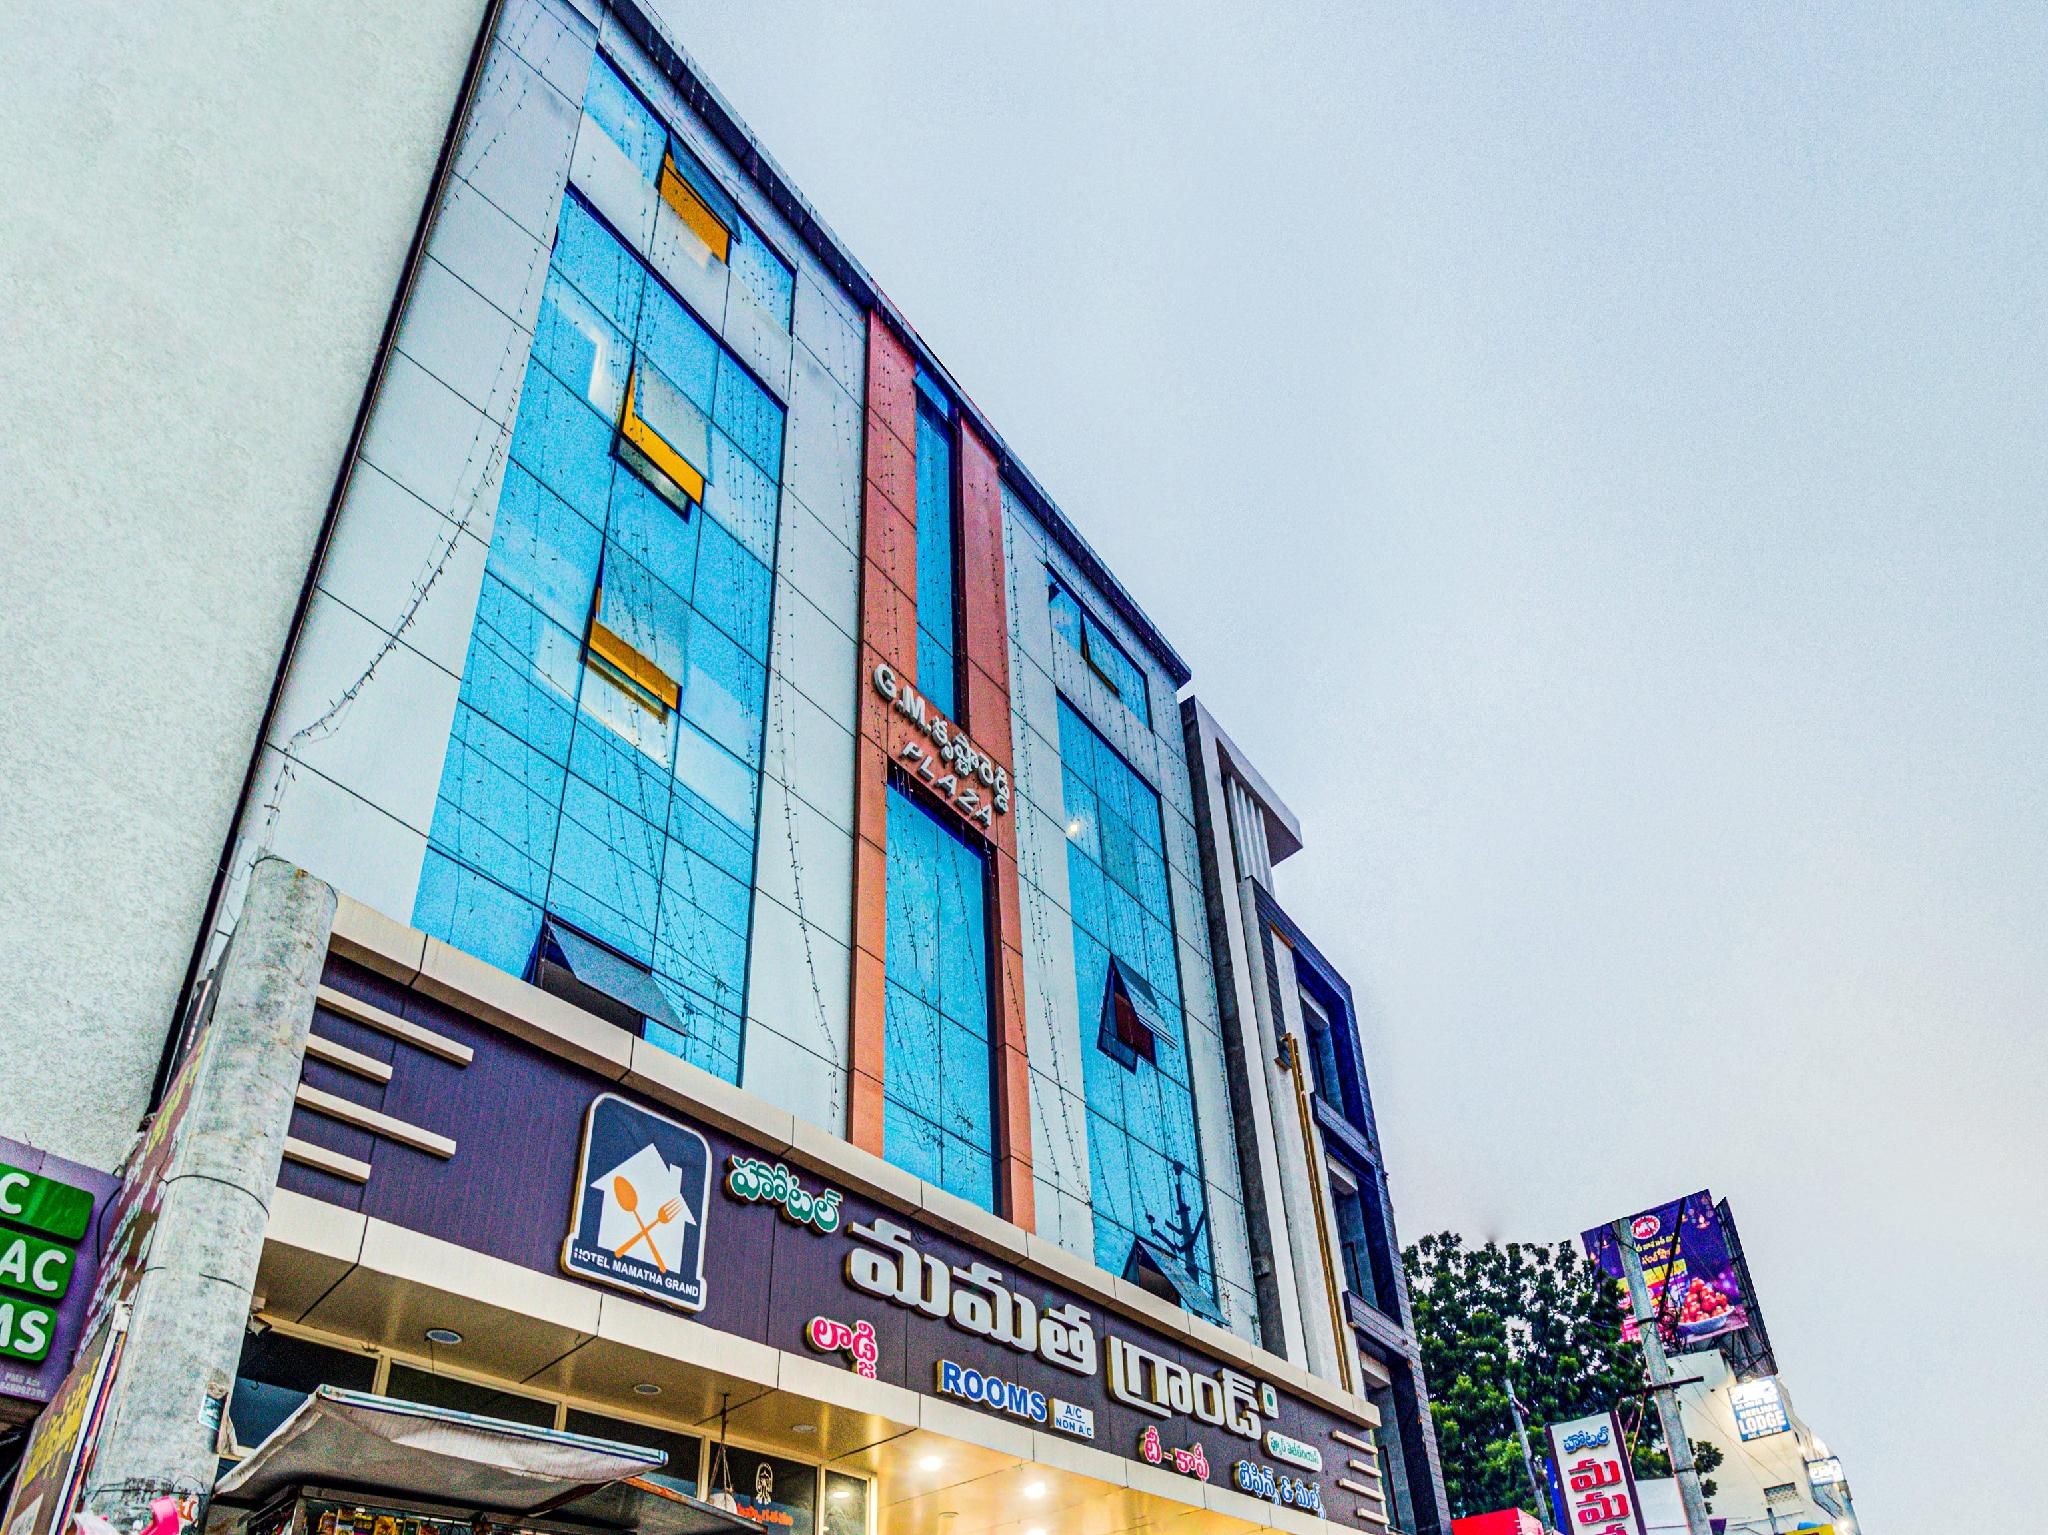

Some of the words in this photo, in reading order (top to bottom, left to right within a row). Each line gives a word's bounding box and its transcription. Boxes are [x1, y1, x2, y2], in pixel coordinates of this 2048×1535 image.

[901, 742, 993, 827] PLAZA
[731, 1155, 842, 1232] హోటల్
[573, 1247, 610, 1269] HOTEL
[612, 1260, 663, 1286] MAMATHA
[665, 1278, 699, 1297] GRAND
[850, 1218, 1098, 1375] మమత
[811, 1316, 878, 1380] లాడ్జి
[942, 1360, 1048, 1423] ROOMS
[1065, 1404, 1082, 1419] A/C
[1110, 1335, 1262, 1440] గ్రాండ్
[1056, 1417, 1075, 1431] NON
[1563, 1425, 1610, 1453] హోటల్
[1738, 1410, 1787, 1435] LODGE
